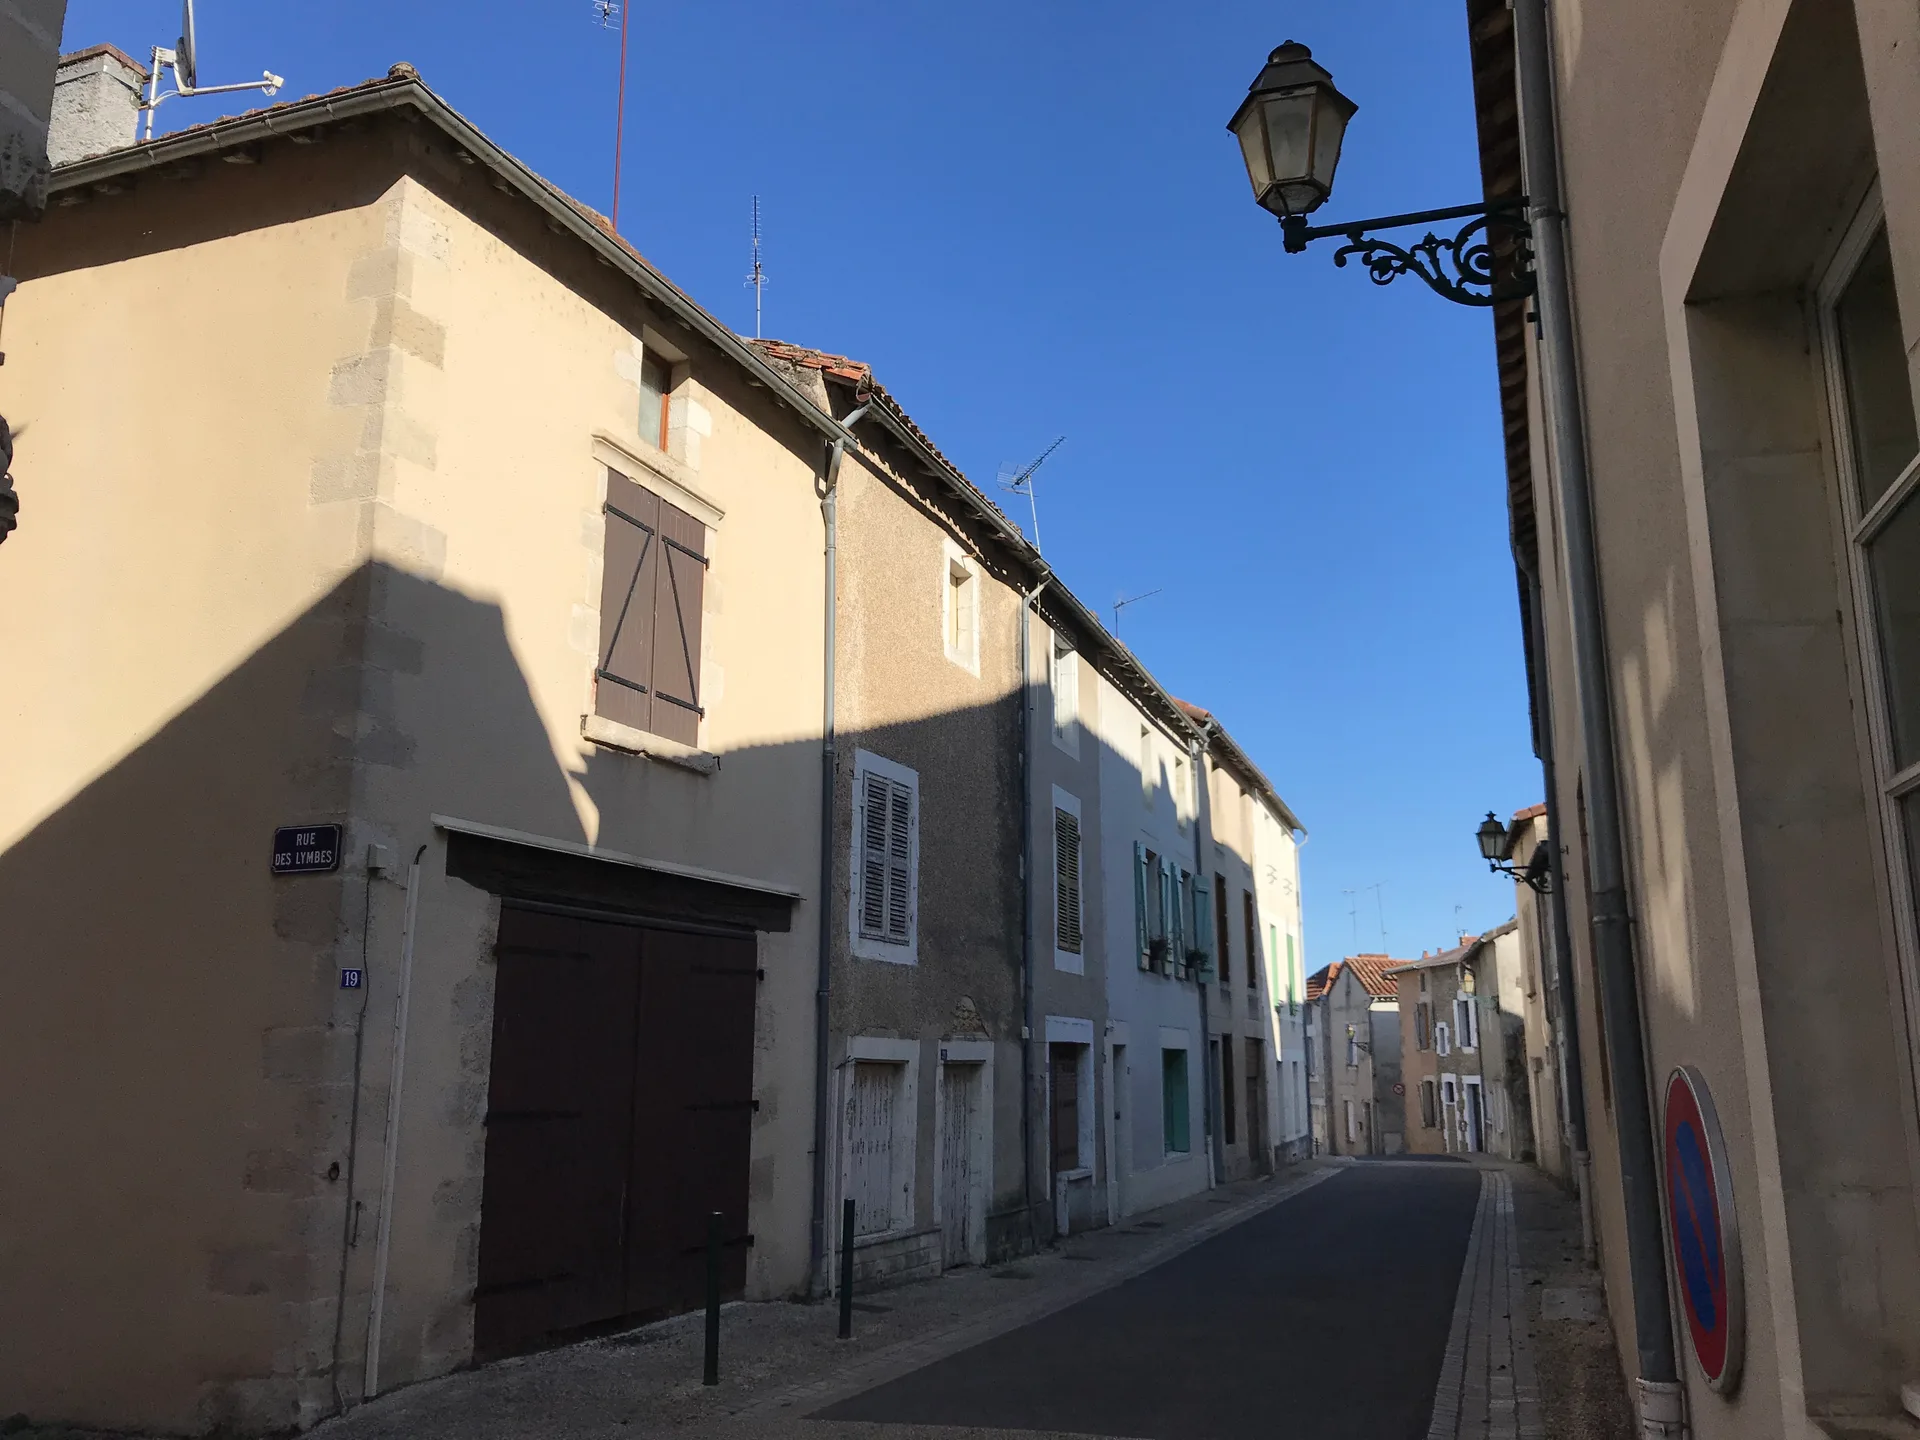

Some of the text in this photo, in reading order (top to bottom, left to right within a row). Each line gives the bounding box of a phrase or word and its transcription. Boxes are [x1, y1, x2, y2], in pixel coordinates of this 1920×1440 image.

[296, 832, 316, 846] RUE
[275, 850, 332, 866] DES LYMBES
[345, 971, 358, 987] 19
